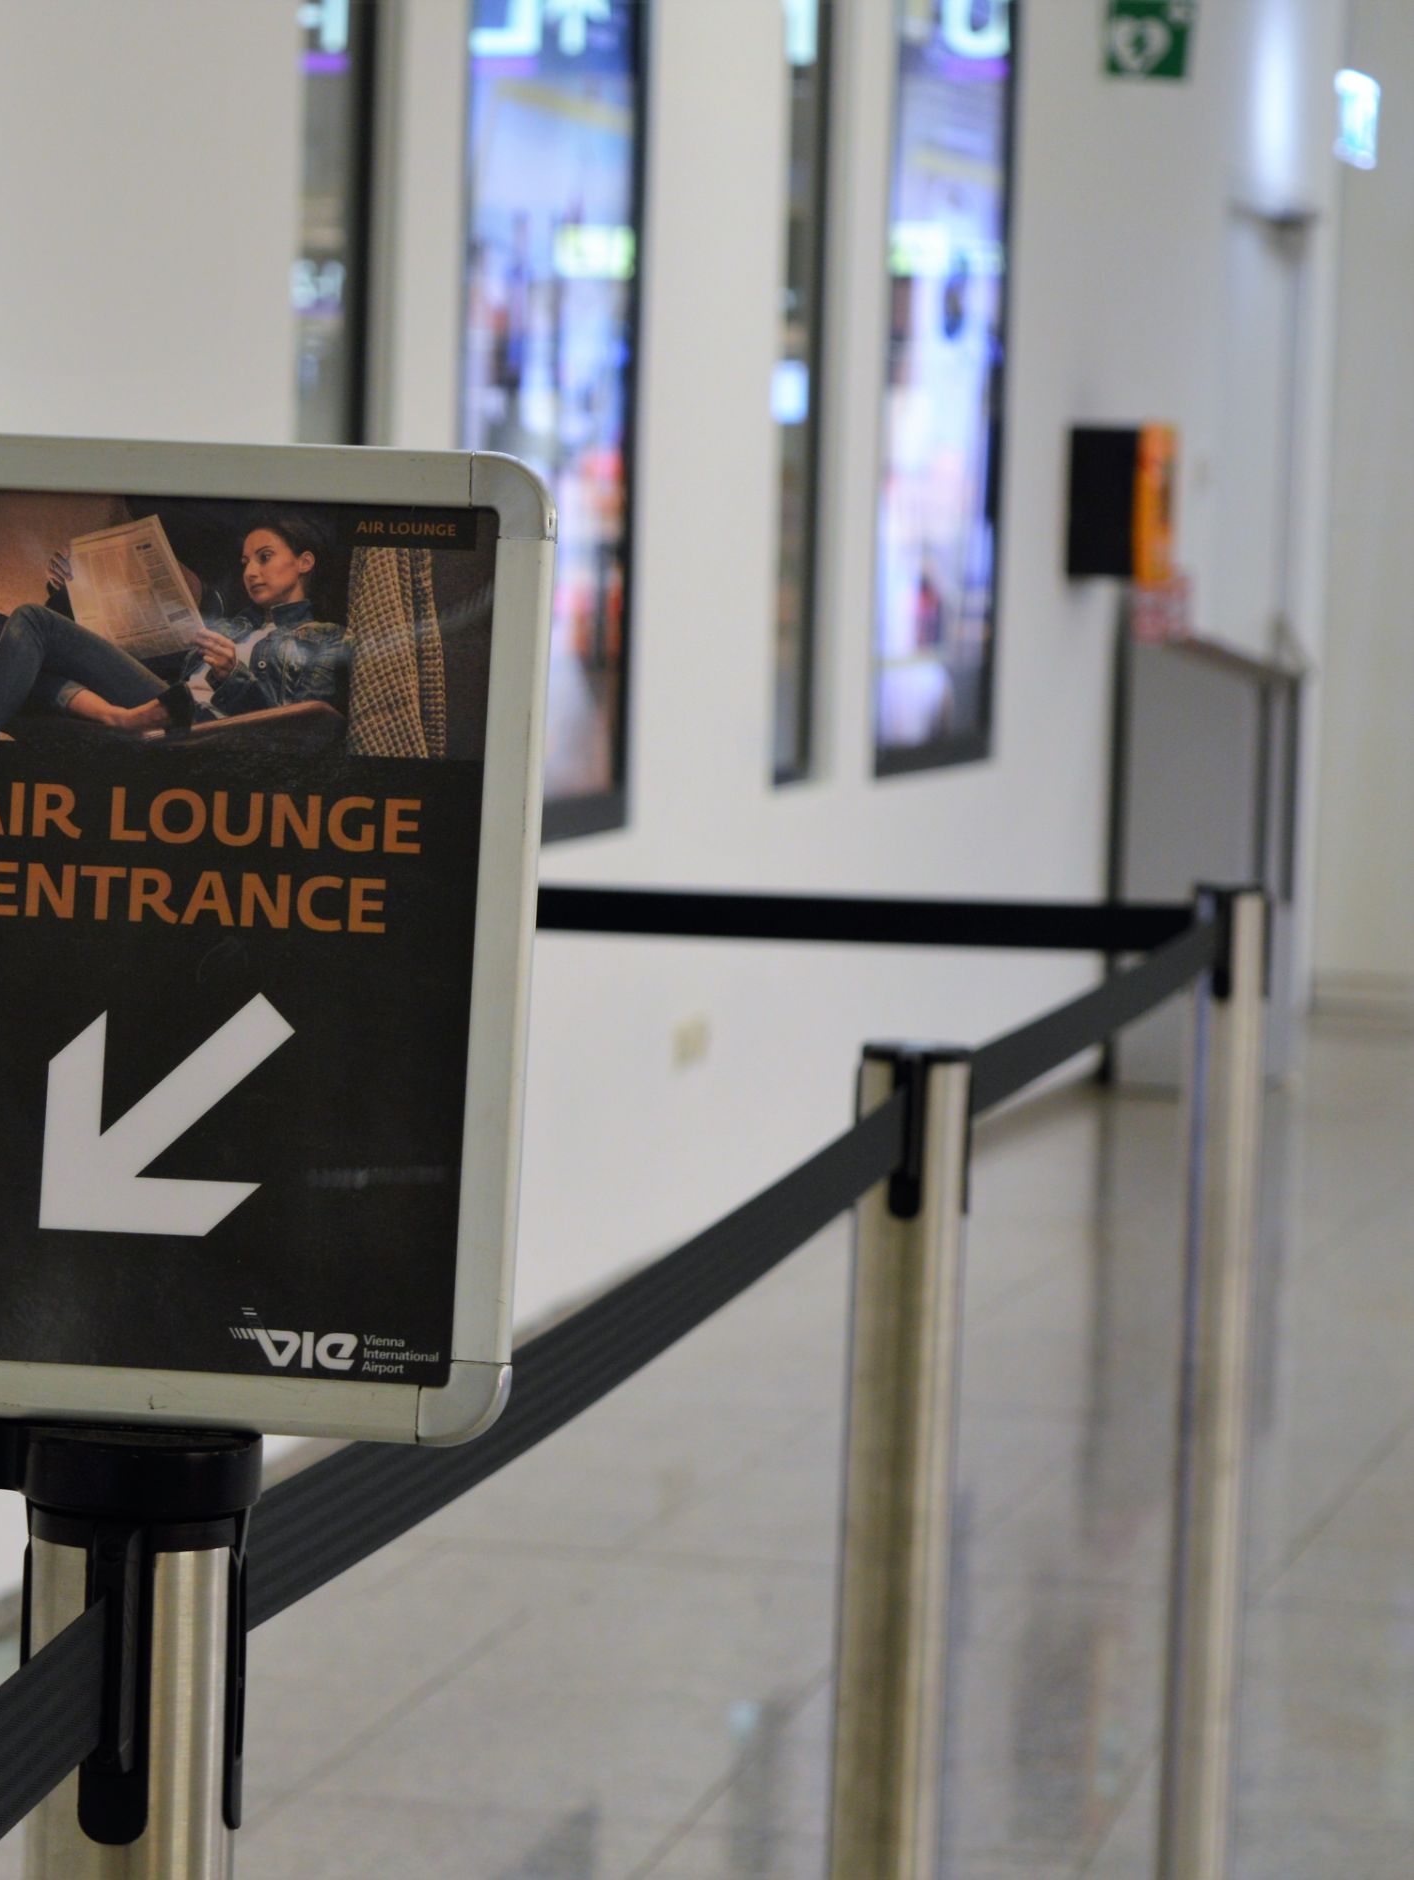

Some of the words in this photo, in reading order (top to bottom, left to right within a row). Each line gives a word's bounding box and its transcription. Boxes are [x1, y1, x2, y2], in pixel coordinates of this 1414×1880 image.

[356, 520, 385, 534] AIR
[389, 521, 457, 537] LOUNGE
[109, 785, 422, 854] LOUNGE
[363, 1334, 406, 1348] Vienna
[363, 1347, 440, 1363] International
[361, 1360, 405, 1375] Airport
